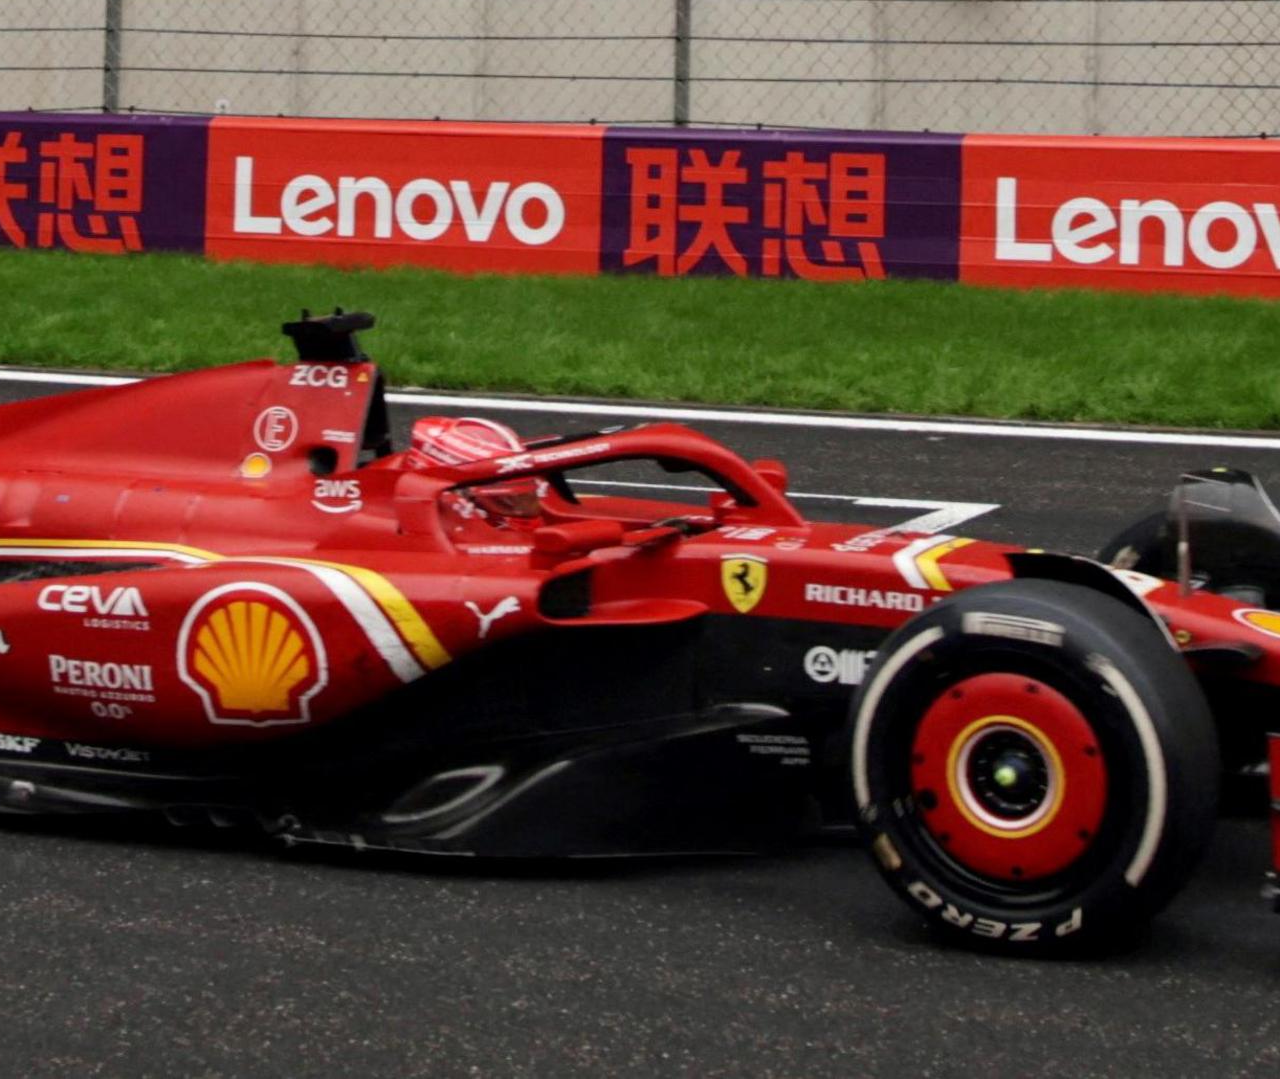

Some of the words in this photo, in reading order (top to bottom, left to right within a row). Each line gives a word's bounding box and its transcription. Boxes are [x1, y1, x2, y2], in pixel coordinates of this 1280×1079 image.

[234, 156, 565, 246] Lenovo
[624, 147, 888, 282] 联想
[314, 479, 361, 498] aws
[805, 583, 924, 612] RICHARD
[82, 618, 151, 631] LOGISTICS
[48, 654, 154, 692] PERONI
